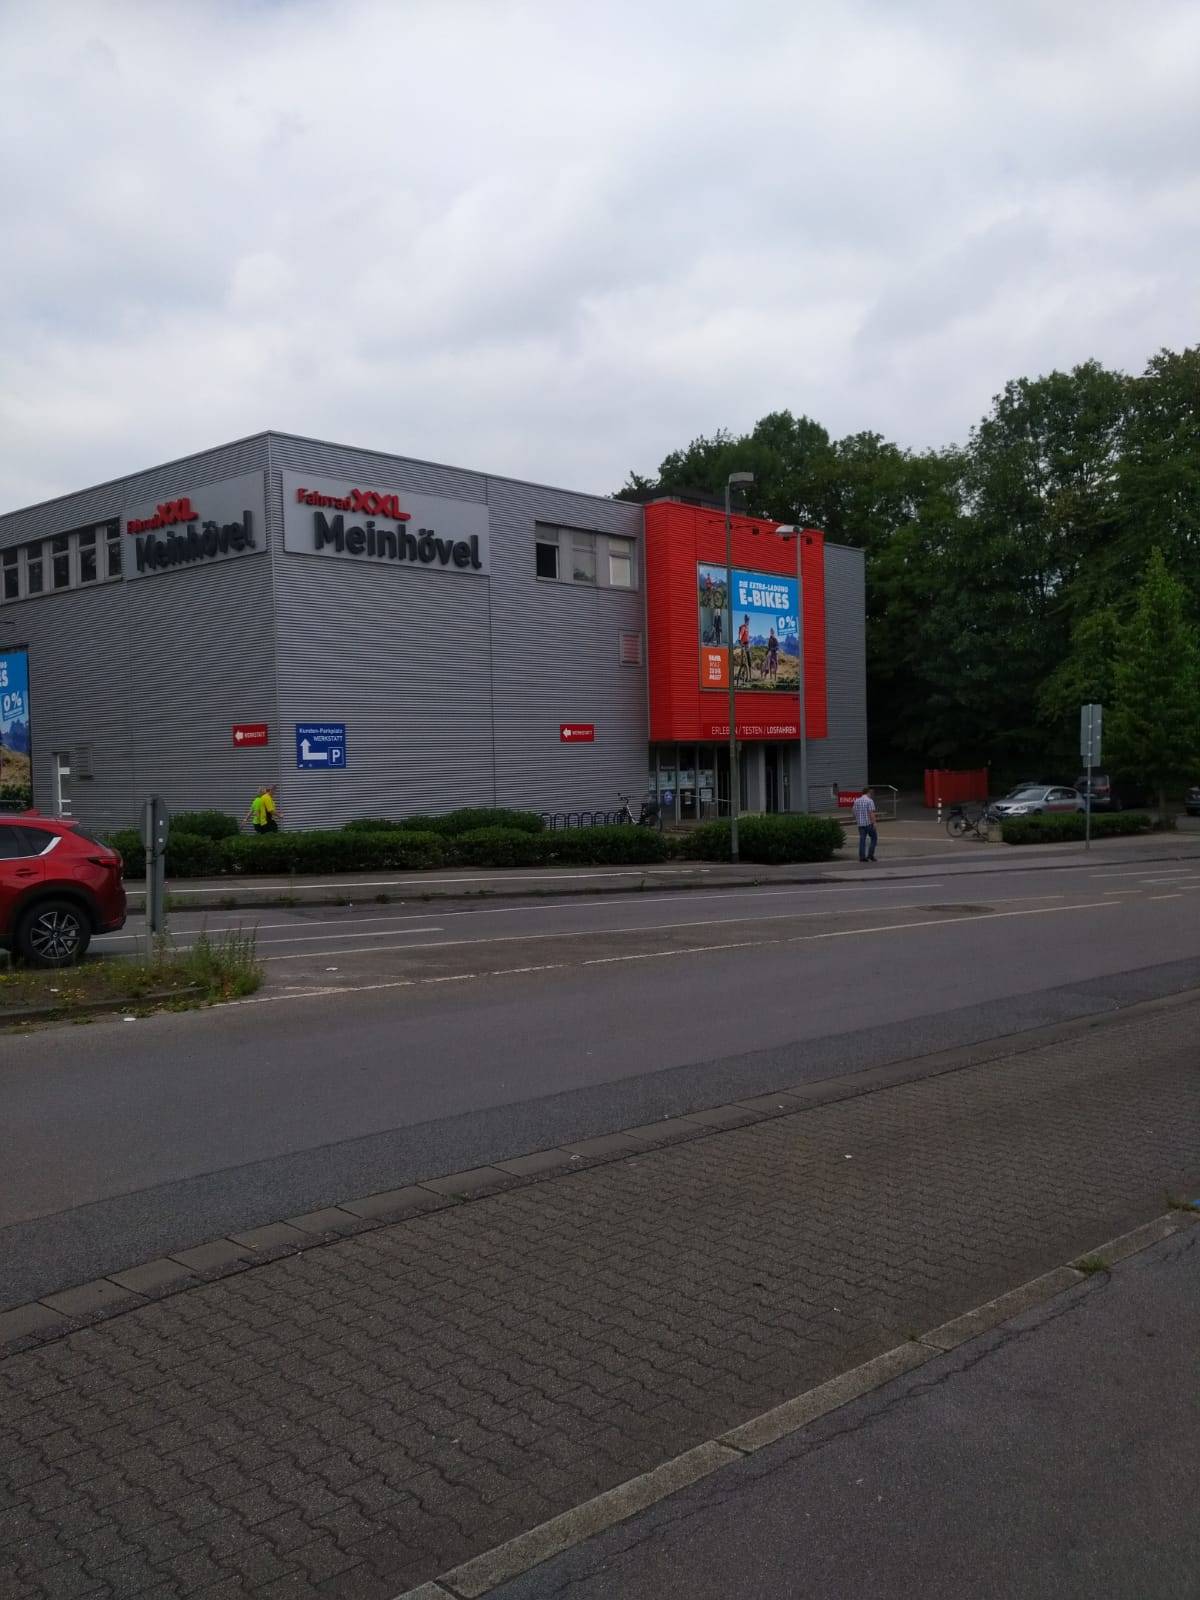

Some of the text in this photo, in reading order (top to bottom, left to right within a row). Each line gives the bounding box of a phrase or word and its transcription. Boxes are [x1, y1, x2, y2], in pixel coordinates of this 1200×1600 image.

[351, 487, 411, 522] XXL
[135, 509, 256, 573] Meinhövel
[313, 510, 482, 570] Meinhövel
[739, 588, 790, 610] E-BIKES
[711, 726, 738, 735] ERLEBN
[742, 726, 762, 735] TESTEN
[766, 726, 797, 734] LOSFAHREN
